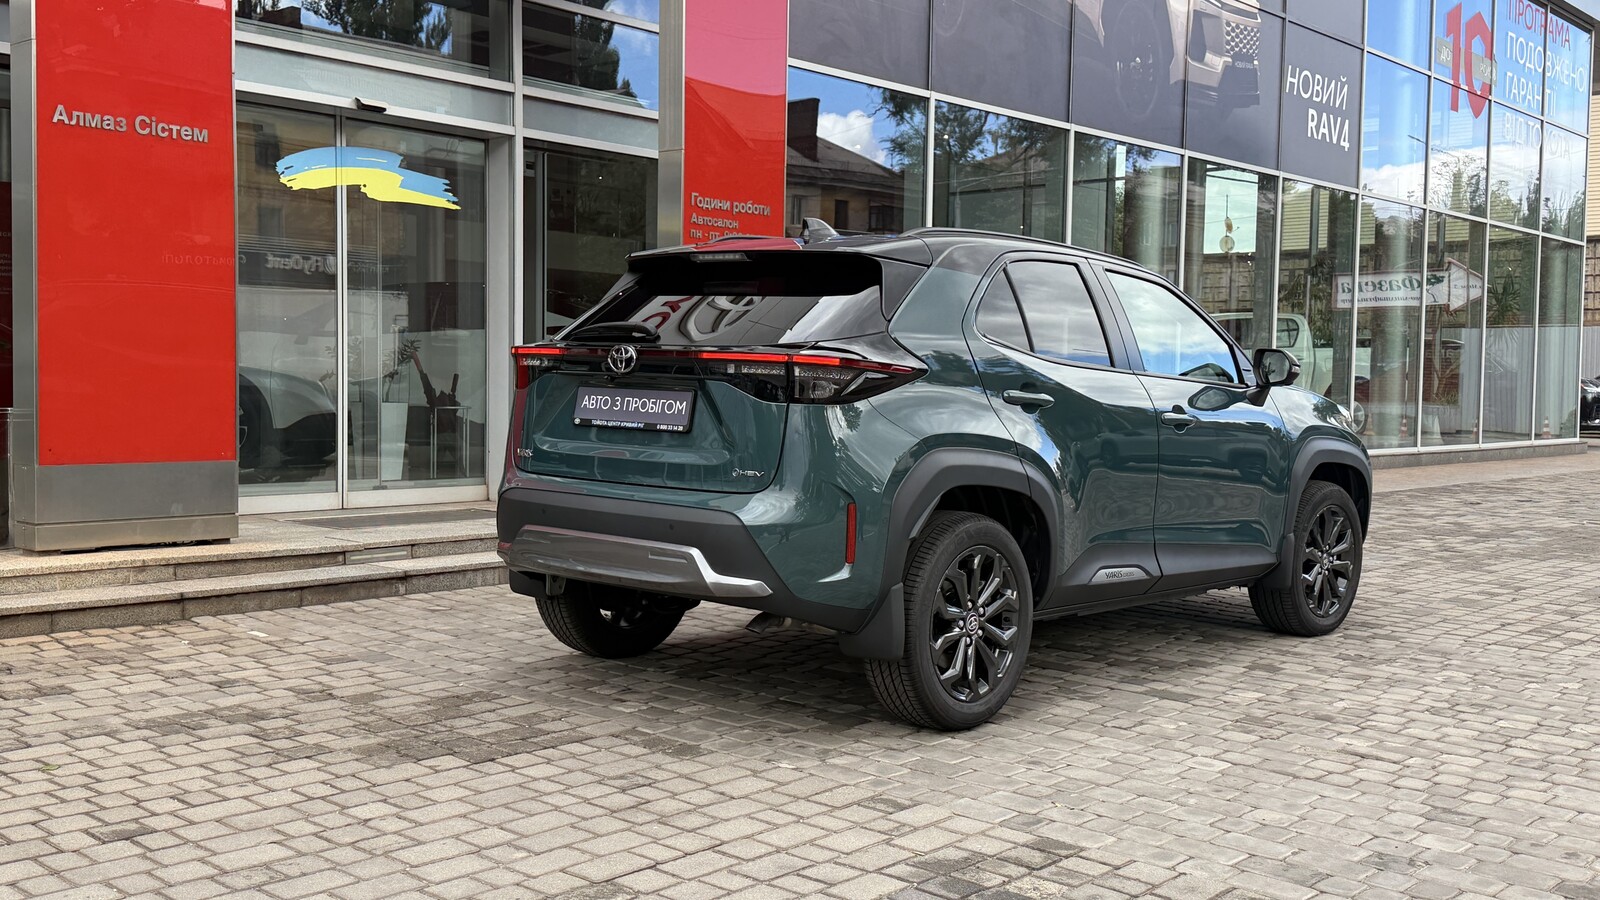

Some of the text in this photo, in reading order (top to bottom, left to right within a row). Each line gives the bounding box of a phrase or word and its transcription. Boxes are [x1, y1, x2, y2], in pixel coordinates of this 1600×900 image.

[1446, 2, 1492, 119] 10
[1286, 65, 1348, 110] НОВИЙ
[52, 104, 209, 143] Алмаз Сістем
[1307, 108, 1350, 152] RAV4
[691, 192, 771, 216] Години роботи
[690, 212, 739, 229] Автосалон
[690, 229, 703, 239] пн
[581, 395, 611, 410] АВТО
[623, 397, 687, 415] ПРОБІГОМ
[620, 421, 638, 429] КРИВИЙ
[1105, 570, 1123, 579] YARIS
